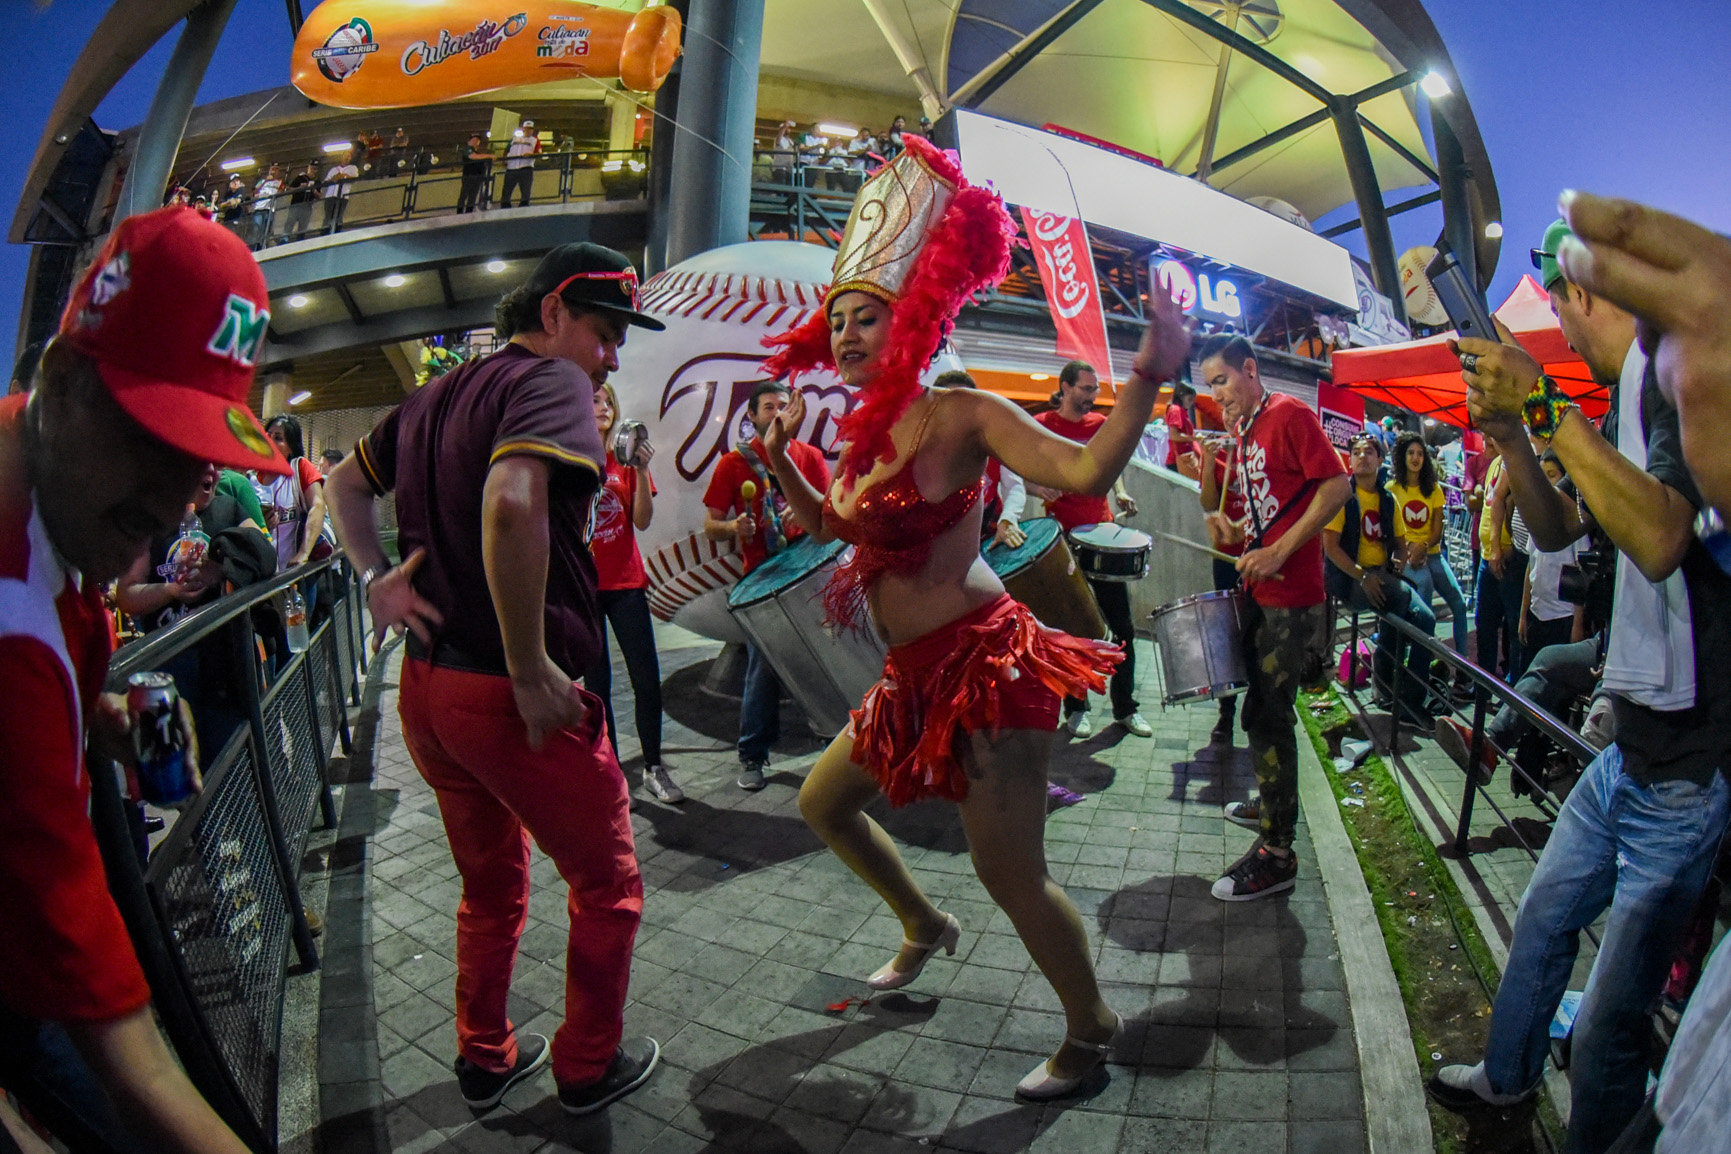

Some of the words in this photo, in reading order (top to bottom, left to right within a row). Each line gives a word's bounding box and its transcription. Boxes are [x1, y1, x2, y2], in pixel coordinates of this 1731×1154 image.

[347, 44, 378, 54] CARIBE
[470, 36, 503, 60] 2017
[1198, 273, 1241, 317] LG
[207, 292, 271, 366] M
[1404, 506, 1428, 523] M
